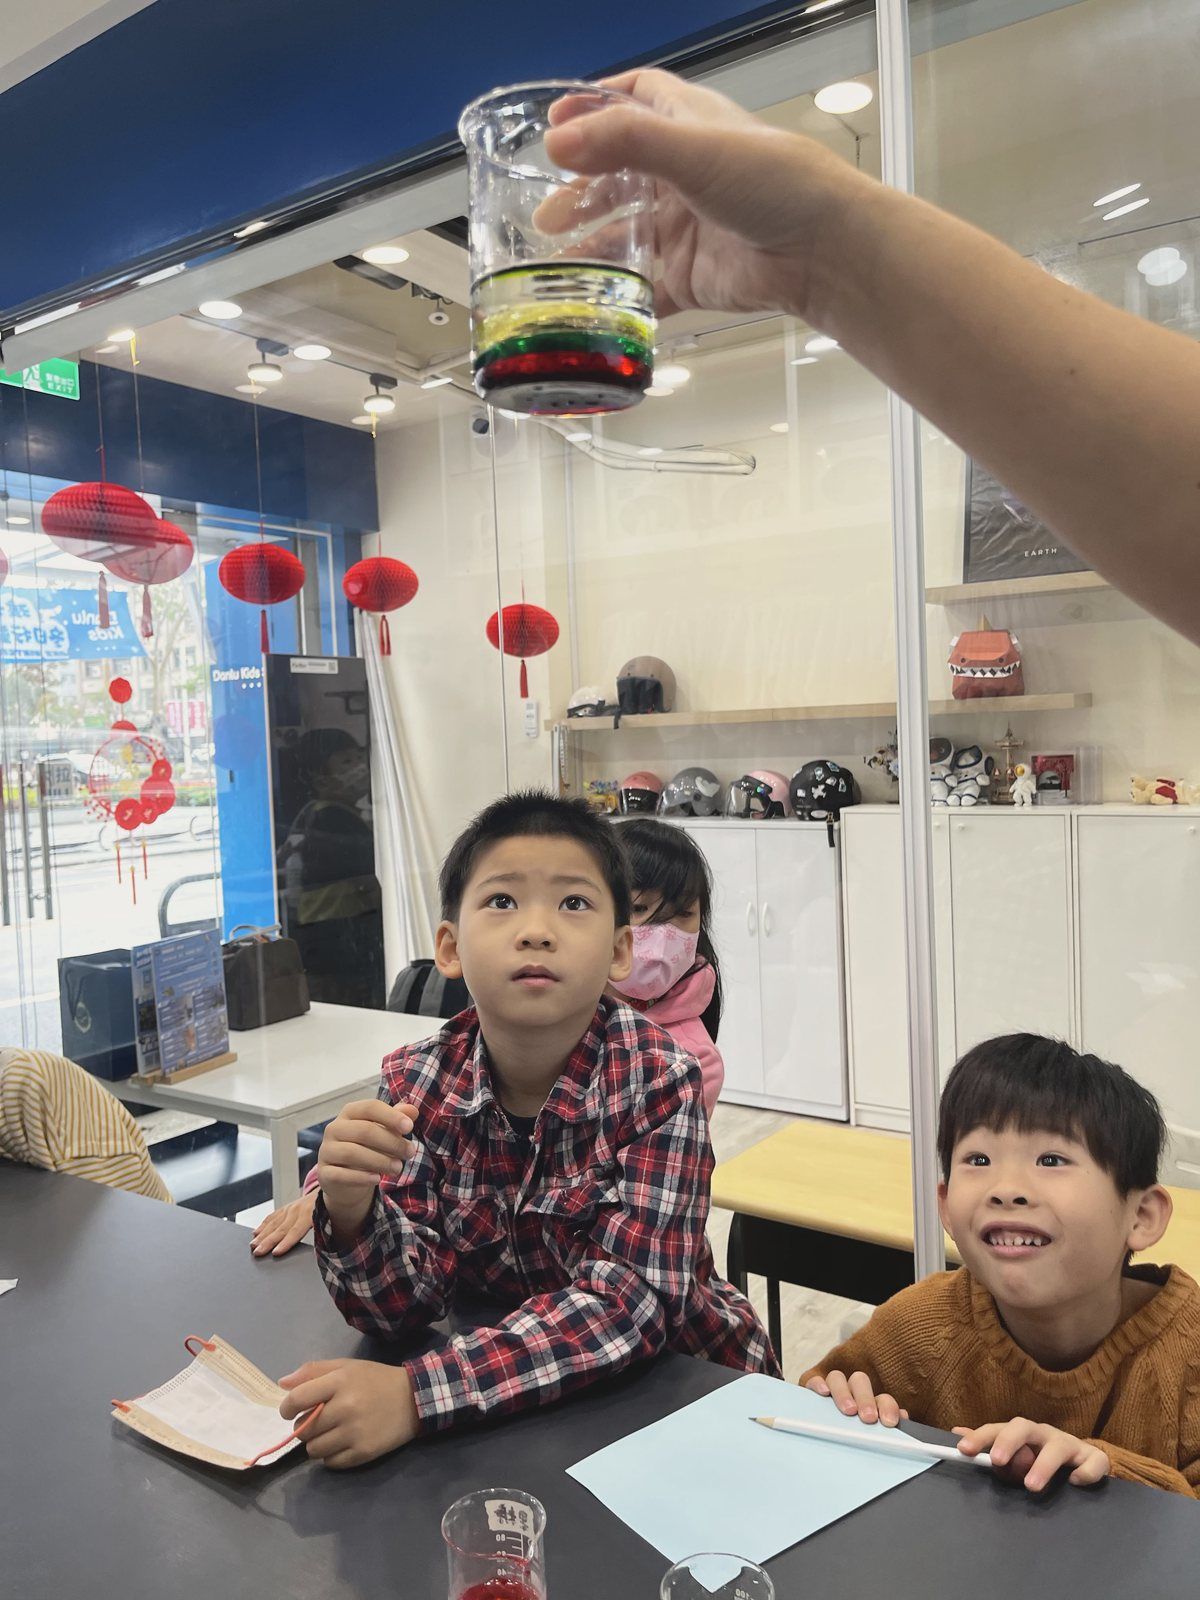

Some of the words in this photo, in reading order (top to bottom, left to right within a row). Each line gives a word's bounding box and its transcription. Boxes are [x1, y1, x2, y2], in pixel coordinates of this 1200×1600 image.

[47, 382, 74, 394] EXIT
[1024, 548, 1057, 557] EARTH
[240, 666, 261, 679] Kids
